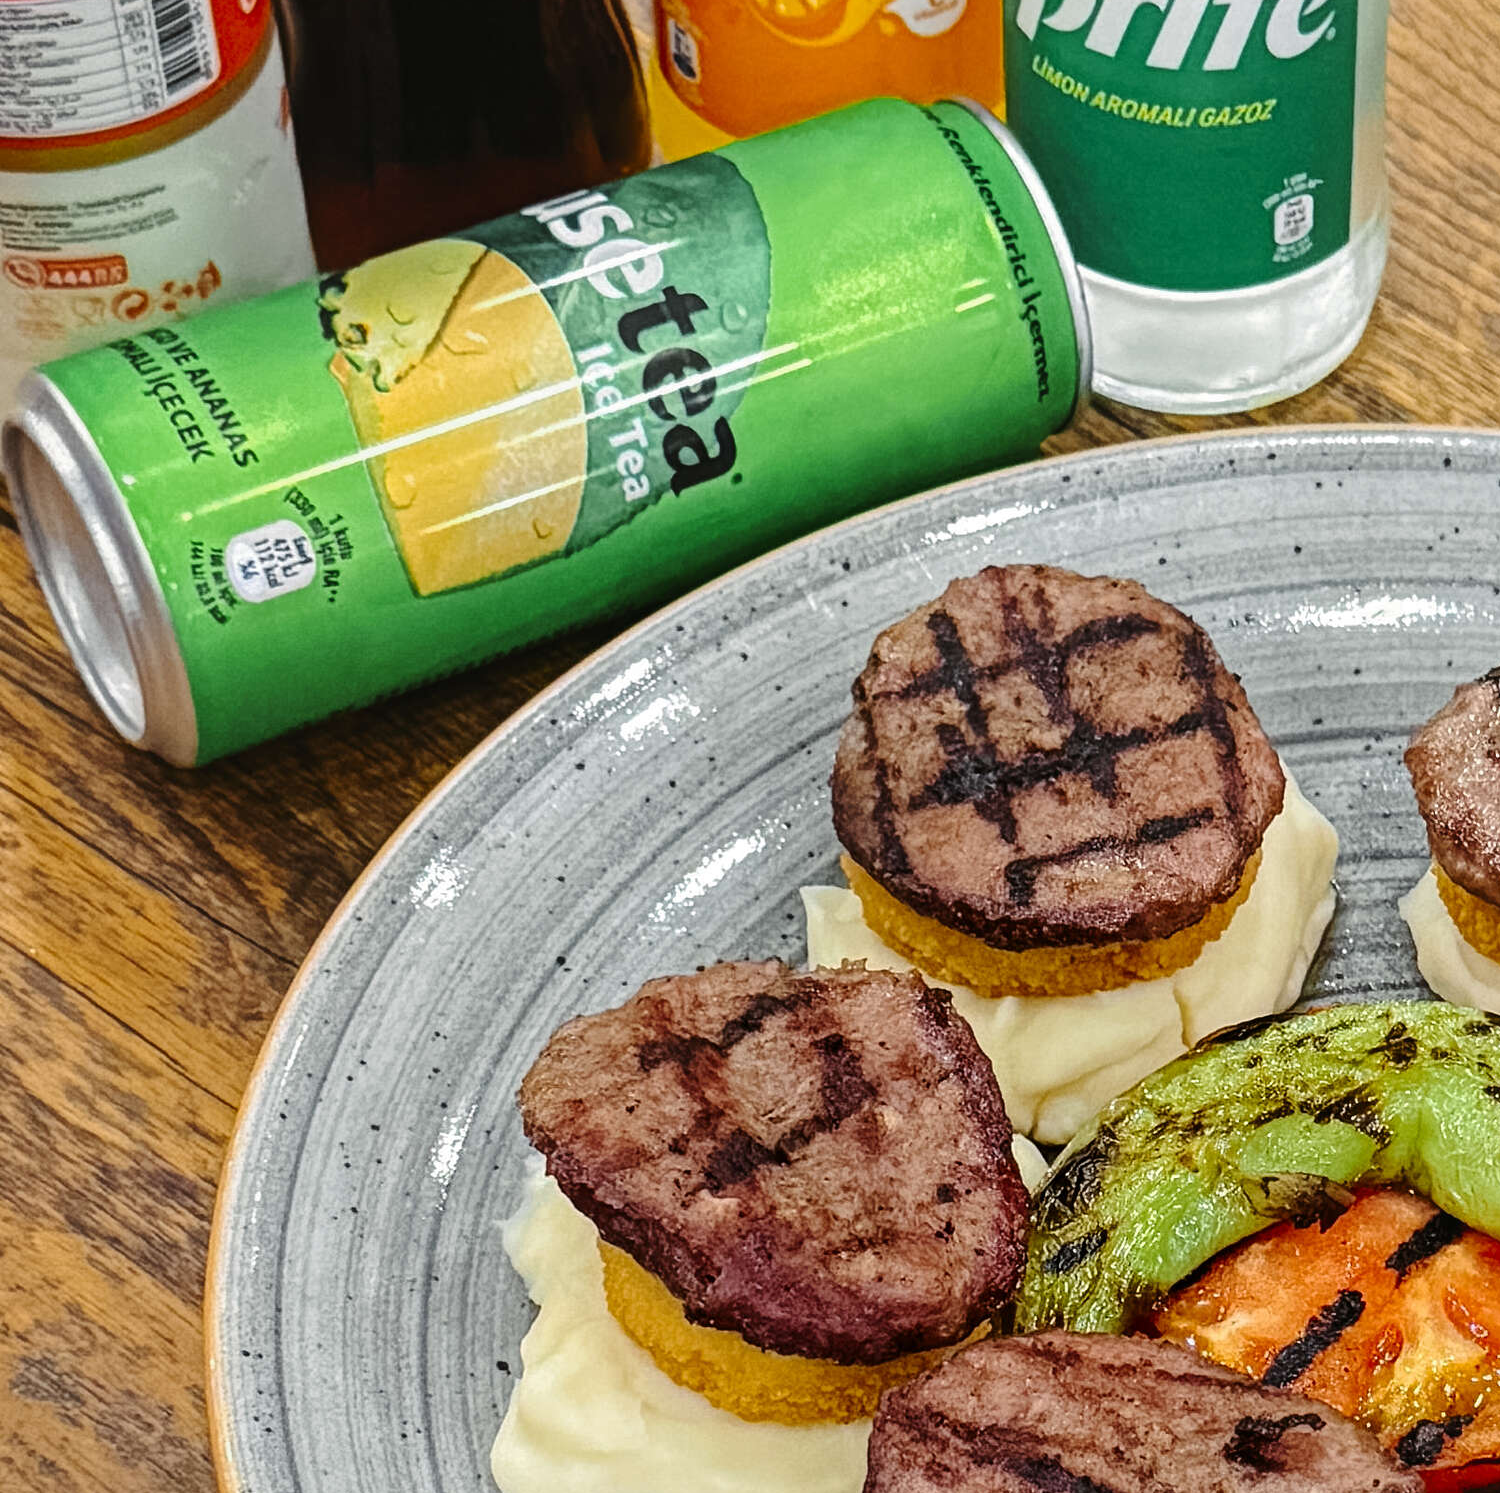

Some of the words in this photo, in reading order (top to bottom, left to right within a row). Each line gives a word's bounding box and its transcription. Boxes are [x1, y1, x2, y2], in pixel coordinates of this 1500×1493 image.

[1089, 91, 1197, 128] AROMALI
[1199, 98, 1279, 128] GAZOZ
[143, 371, 216, 464] İÇECEK
[183, 367, 260, 469] ANANAS
[608, 416, 651, 503] Tea
